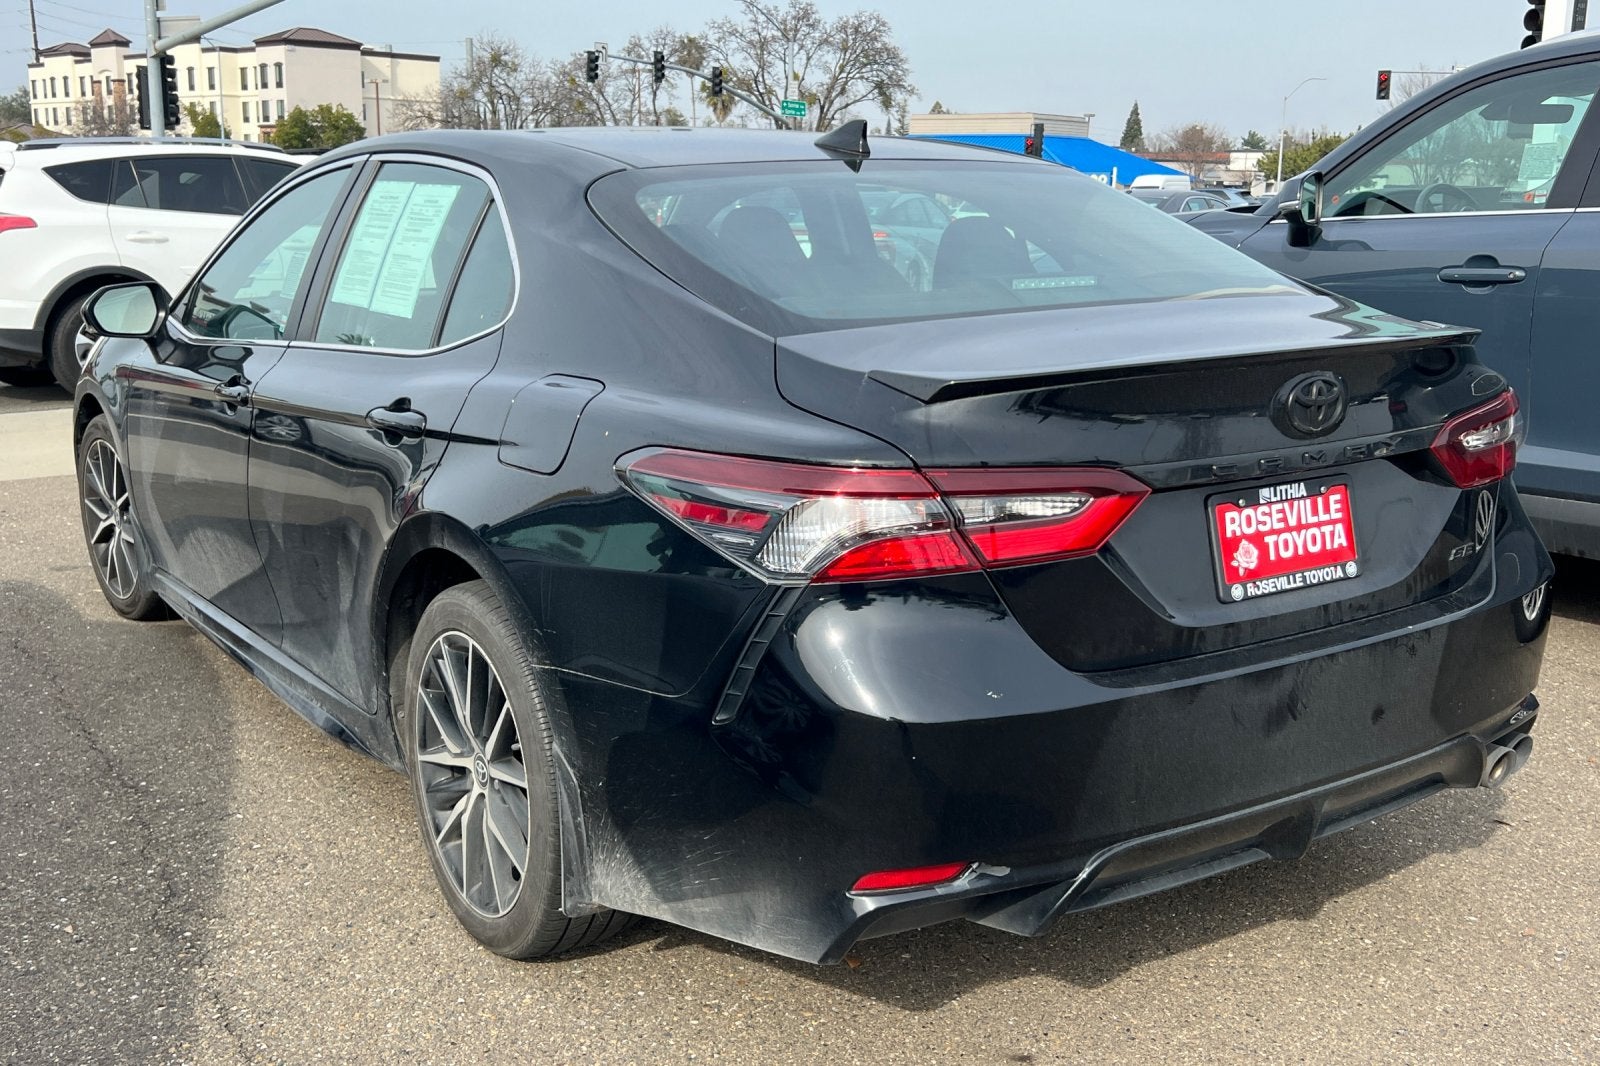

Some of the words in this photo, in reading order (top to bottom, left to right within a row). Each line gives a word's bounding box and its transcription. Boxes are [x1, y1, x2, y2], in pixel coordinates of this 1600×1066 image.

[1269, 482, 1307, 502] LITHIA
[1224, 494, 1343, 538] ROSEVILLE
[1264, 523, 1348, 561] TOYOTA
[1247, 573, 1304, 597] ROSEVILLE
[1304, 566, 1344, 586] TOYOTA
